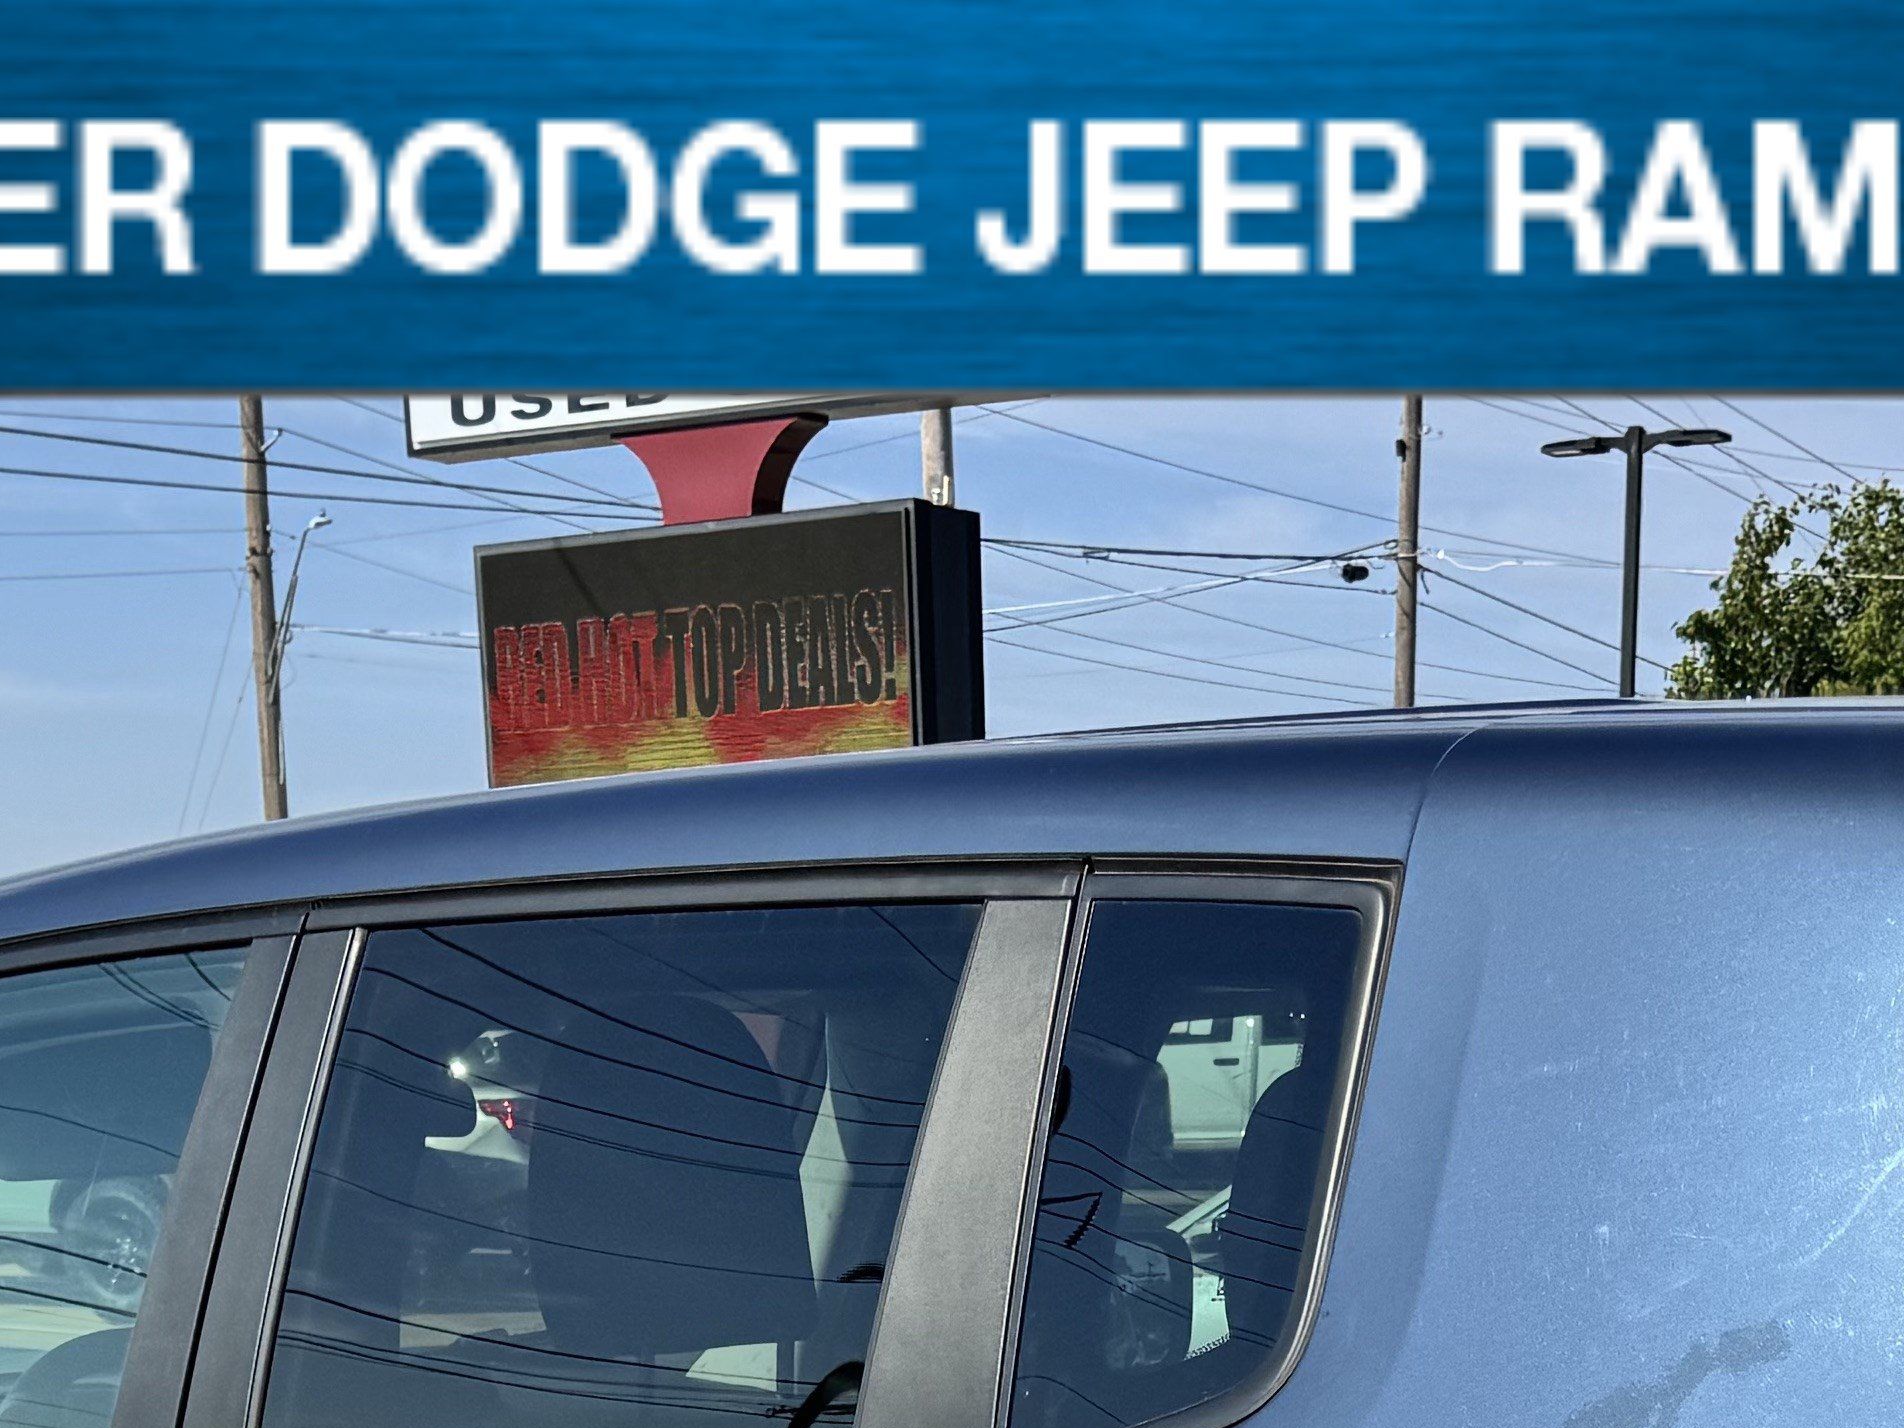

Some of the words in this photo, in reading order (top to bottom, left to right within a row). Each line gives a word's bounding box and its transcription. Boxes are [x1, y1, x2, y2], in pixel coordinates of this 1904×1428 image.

[450, 391, 671, 428] US
[663, 603, 748, 719] TOP
[752, 588, 897, 715] DEALS!
